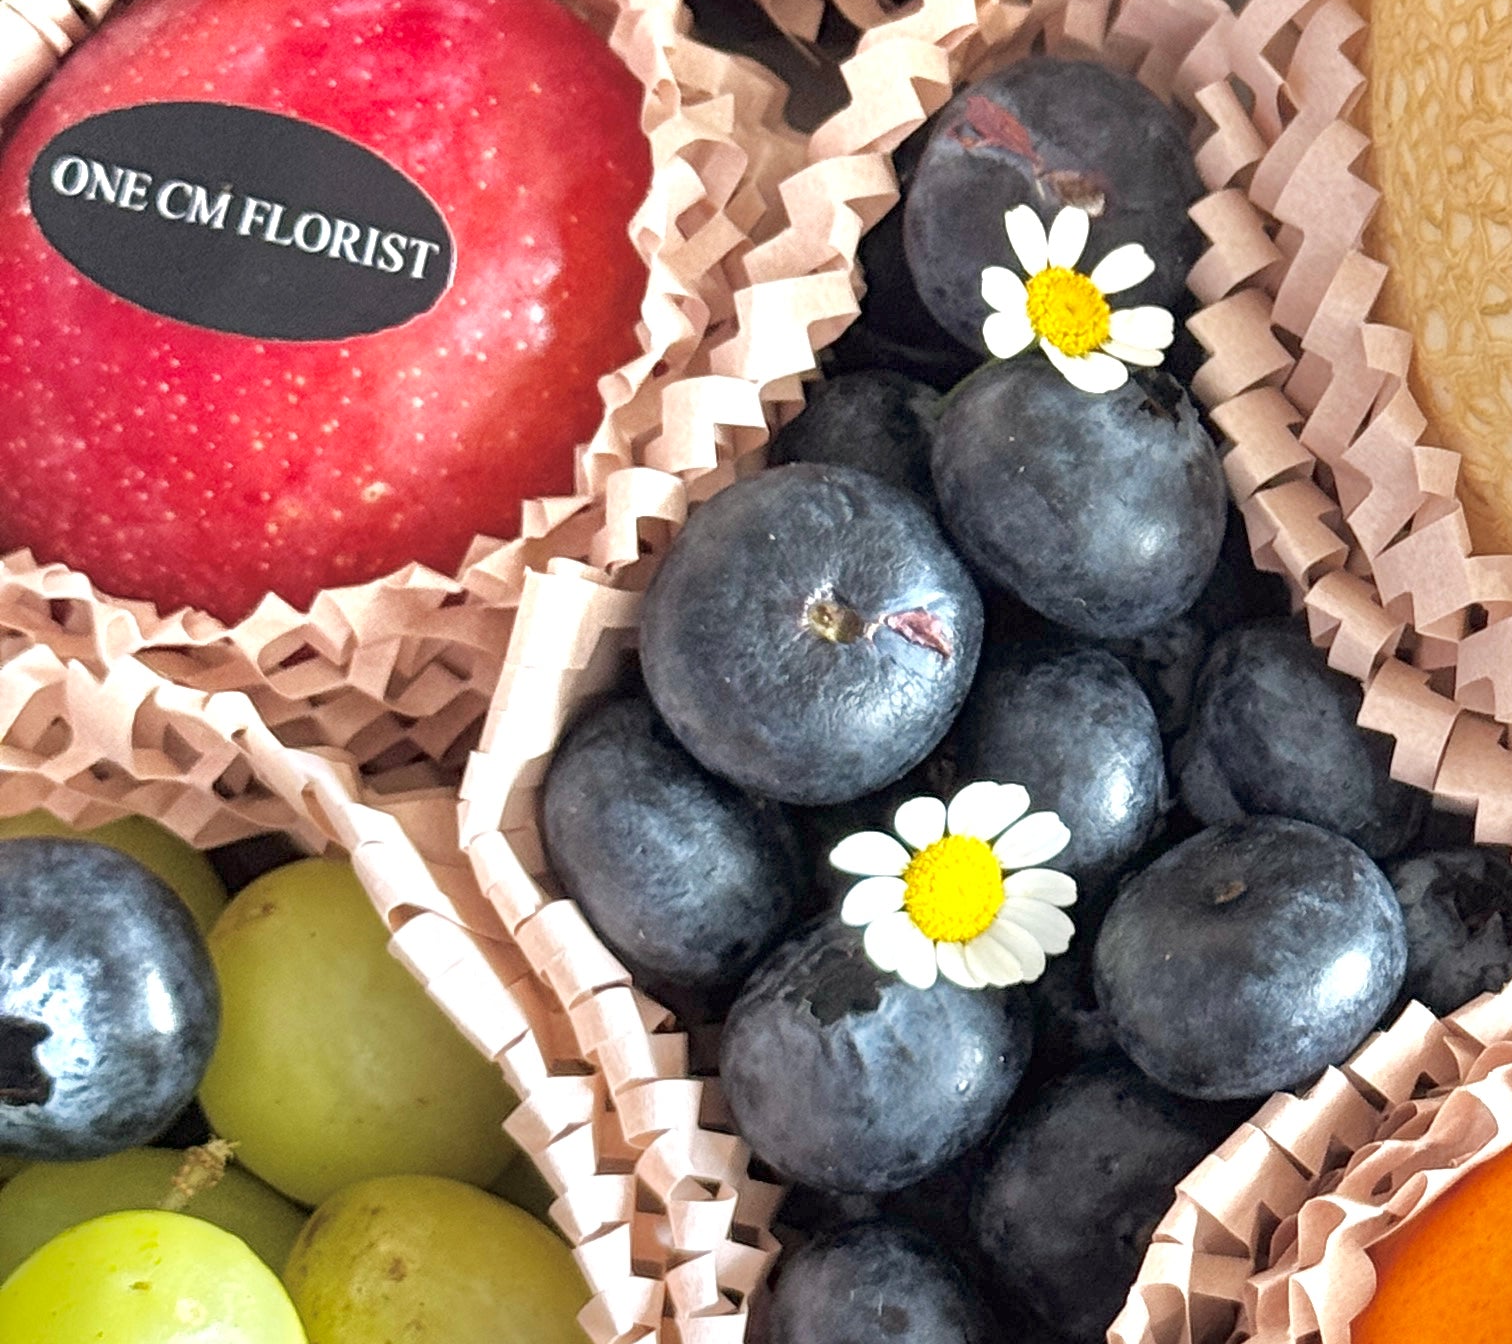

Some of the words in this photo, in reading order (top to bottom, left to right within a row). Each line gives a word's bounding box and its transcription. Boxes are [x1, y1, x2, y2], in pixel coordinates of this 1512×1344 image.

[51, 157, 153, 212] ONE
[156, 179, 233, 229] CM
[237, 196, 440, 279] FLORIST
